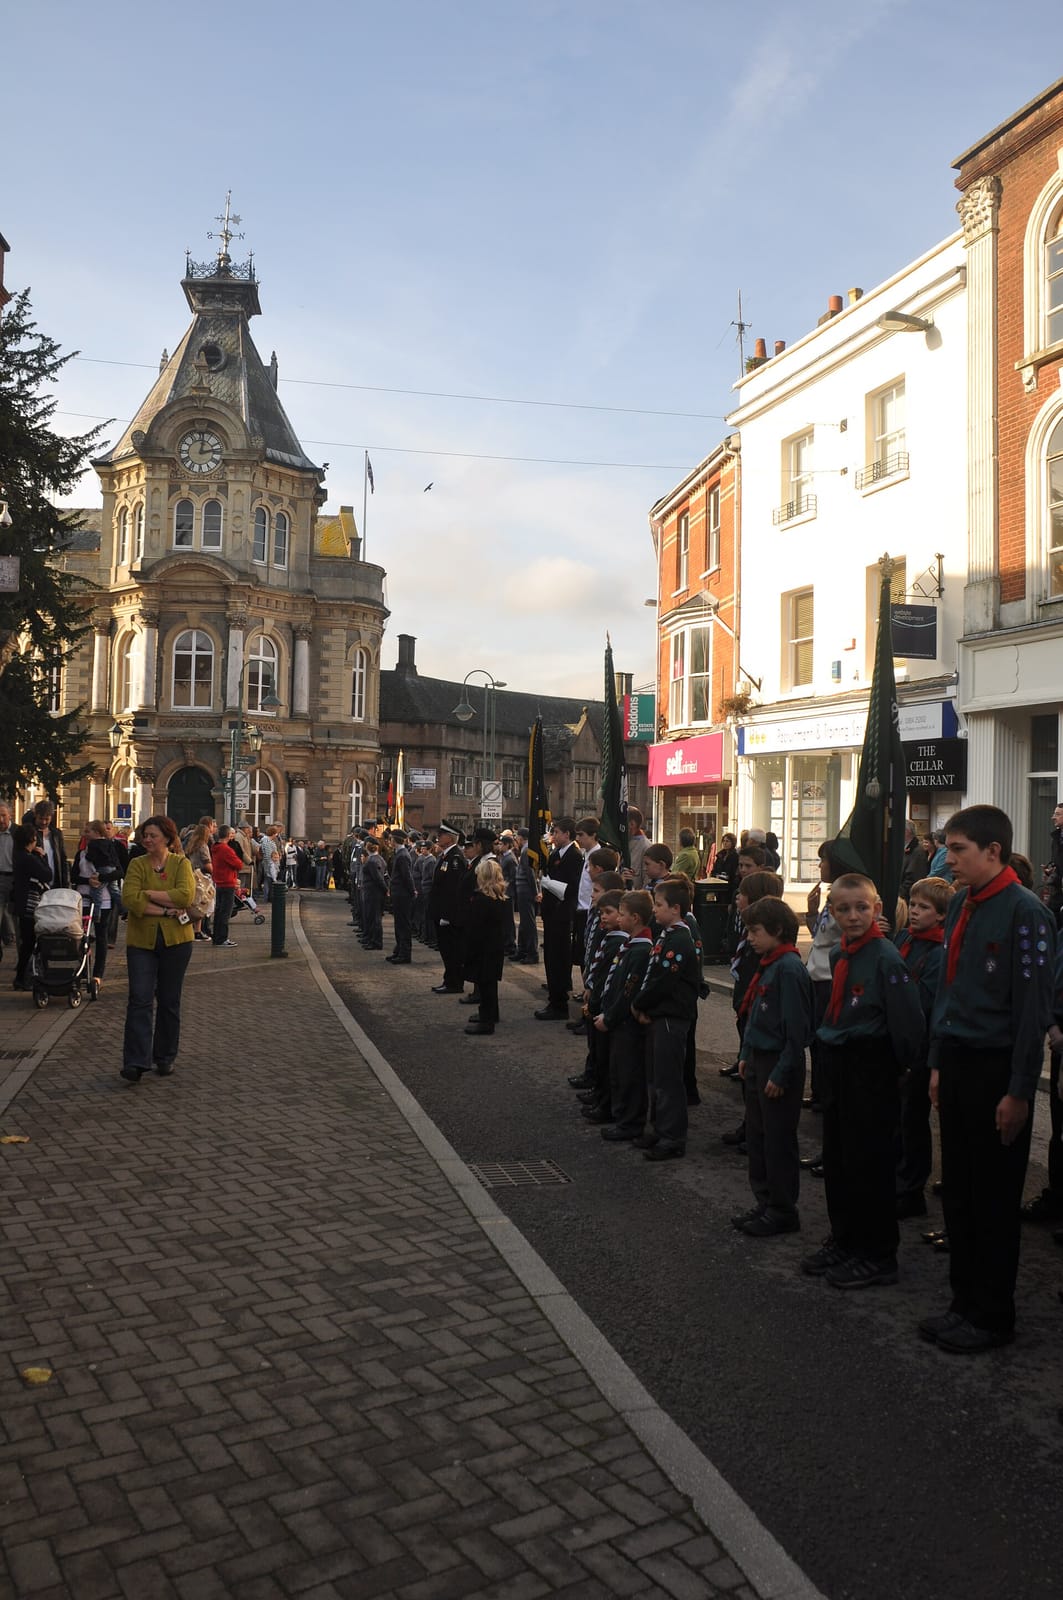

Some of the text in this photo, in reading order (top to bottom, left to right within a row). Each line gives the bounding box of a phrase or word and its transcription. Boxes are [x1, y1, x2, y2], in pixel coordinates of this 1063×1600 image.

[627, 696, 639, 738] Seddons
[917, 745, 936, 757] THE
[666, 749, 683, 776] self
[910, 760, 944, 772] CELLAR
[905, 774, 955, 786] ESTAURANT
